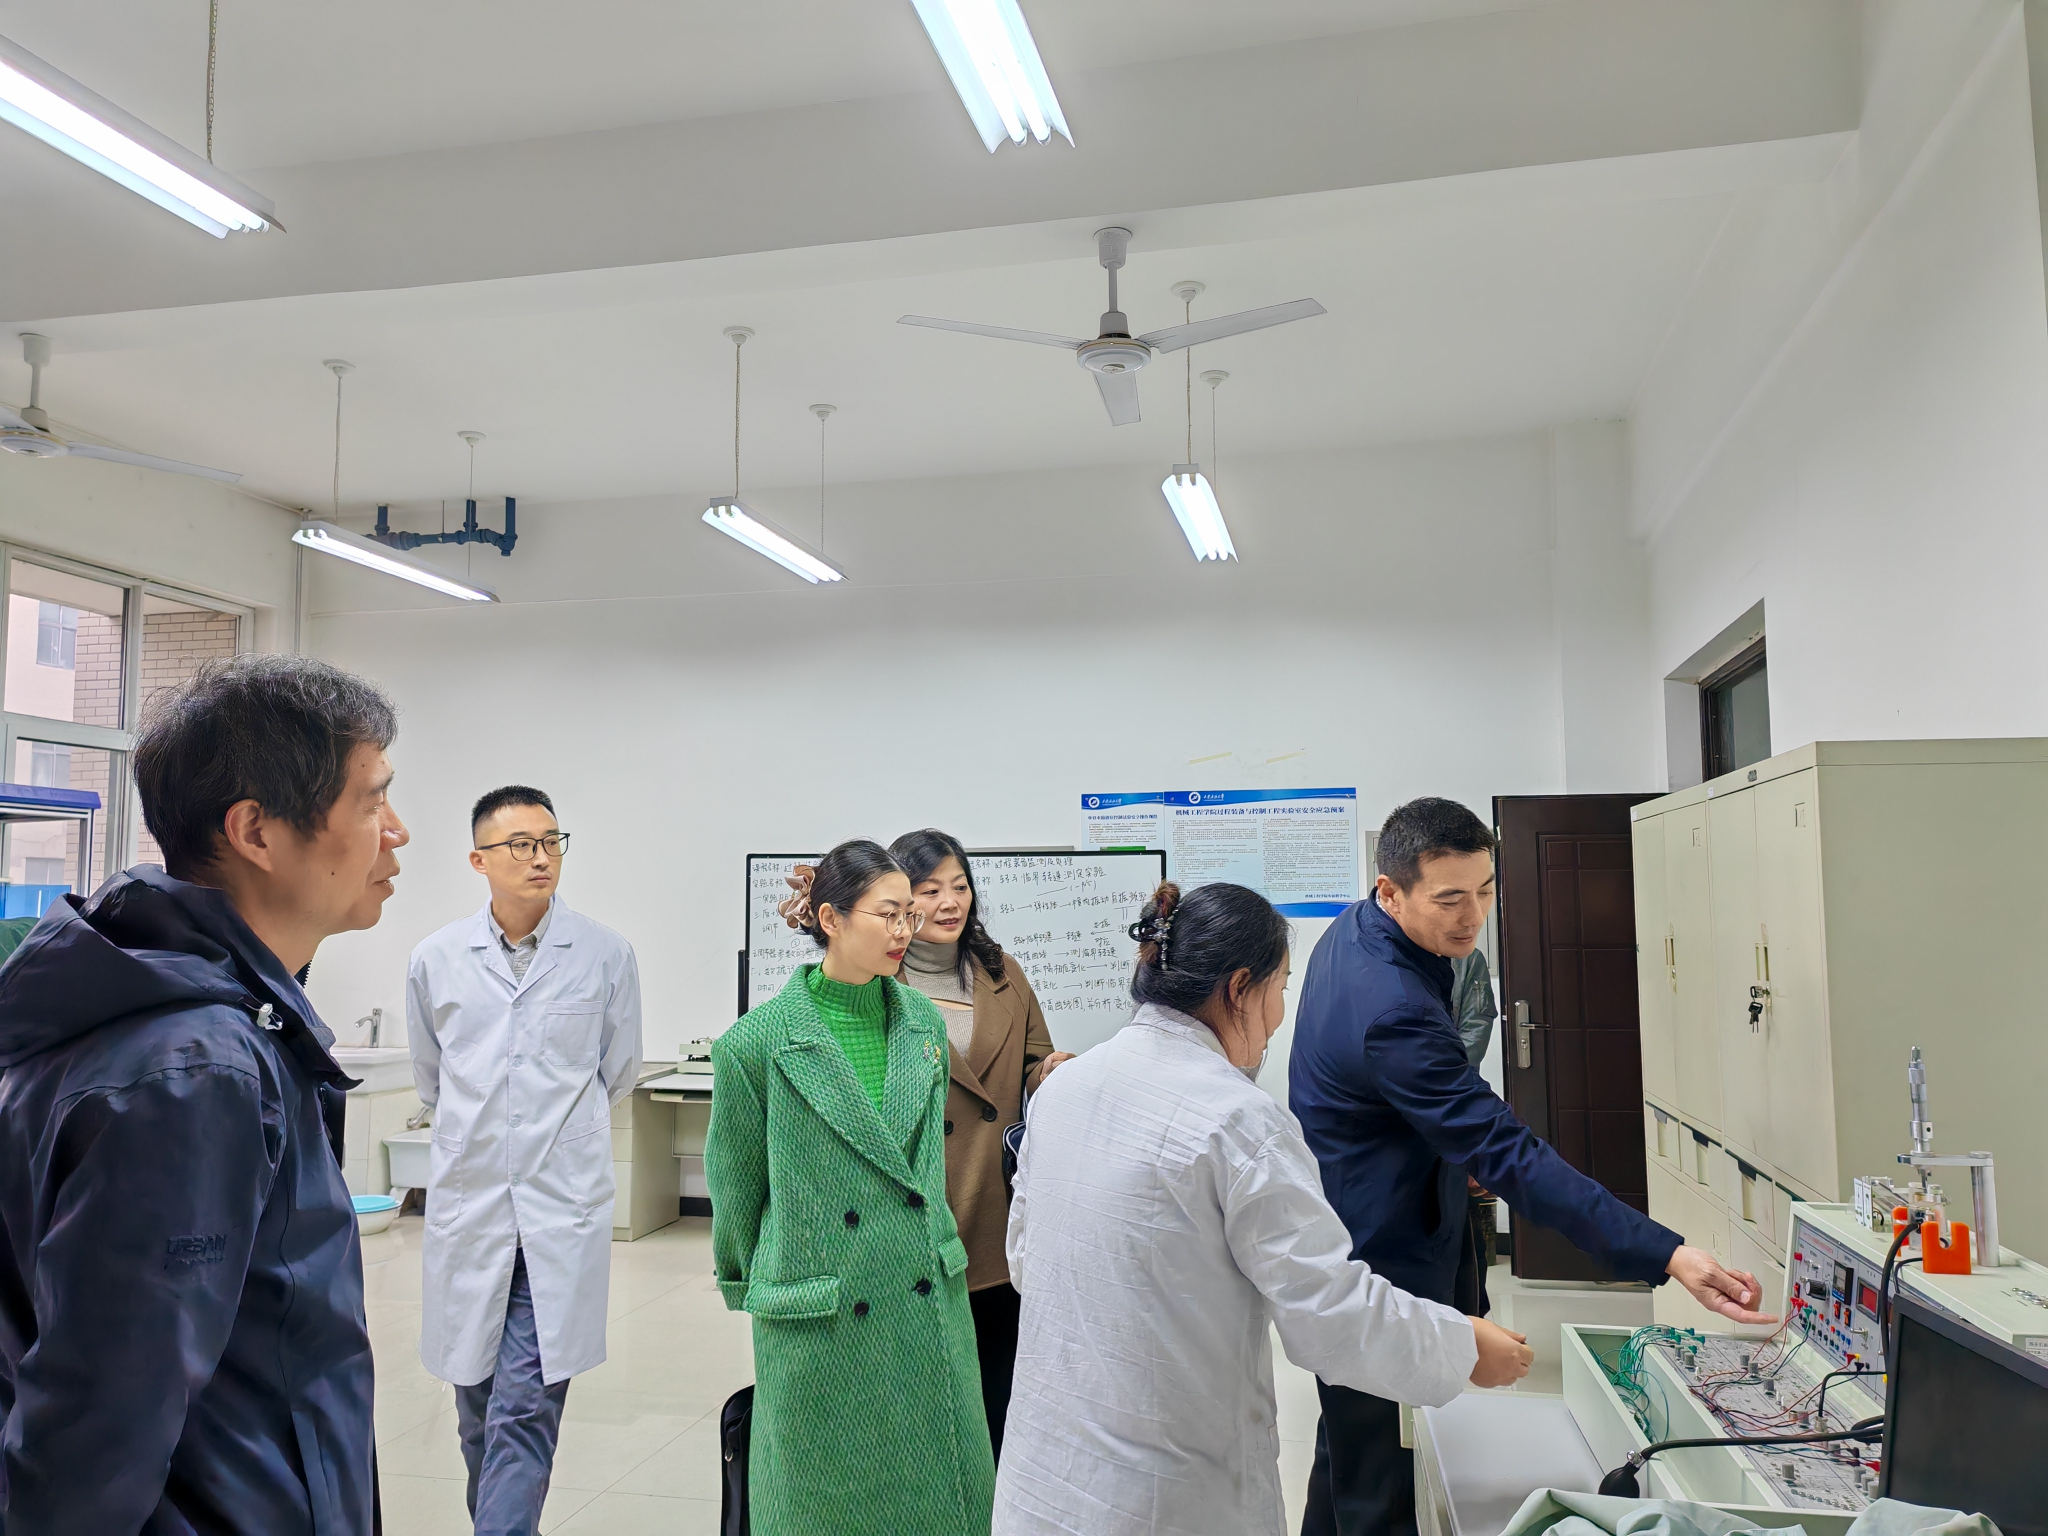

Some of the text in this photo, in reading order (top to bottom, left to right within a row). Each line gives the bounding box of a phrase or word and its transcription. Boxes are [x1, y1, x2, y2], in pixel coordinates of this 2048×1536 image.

[1175, 806, 1345, 816] 机械工程学院过程装备与控制工程实验室安全应急预案
